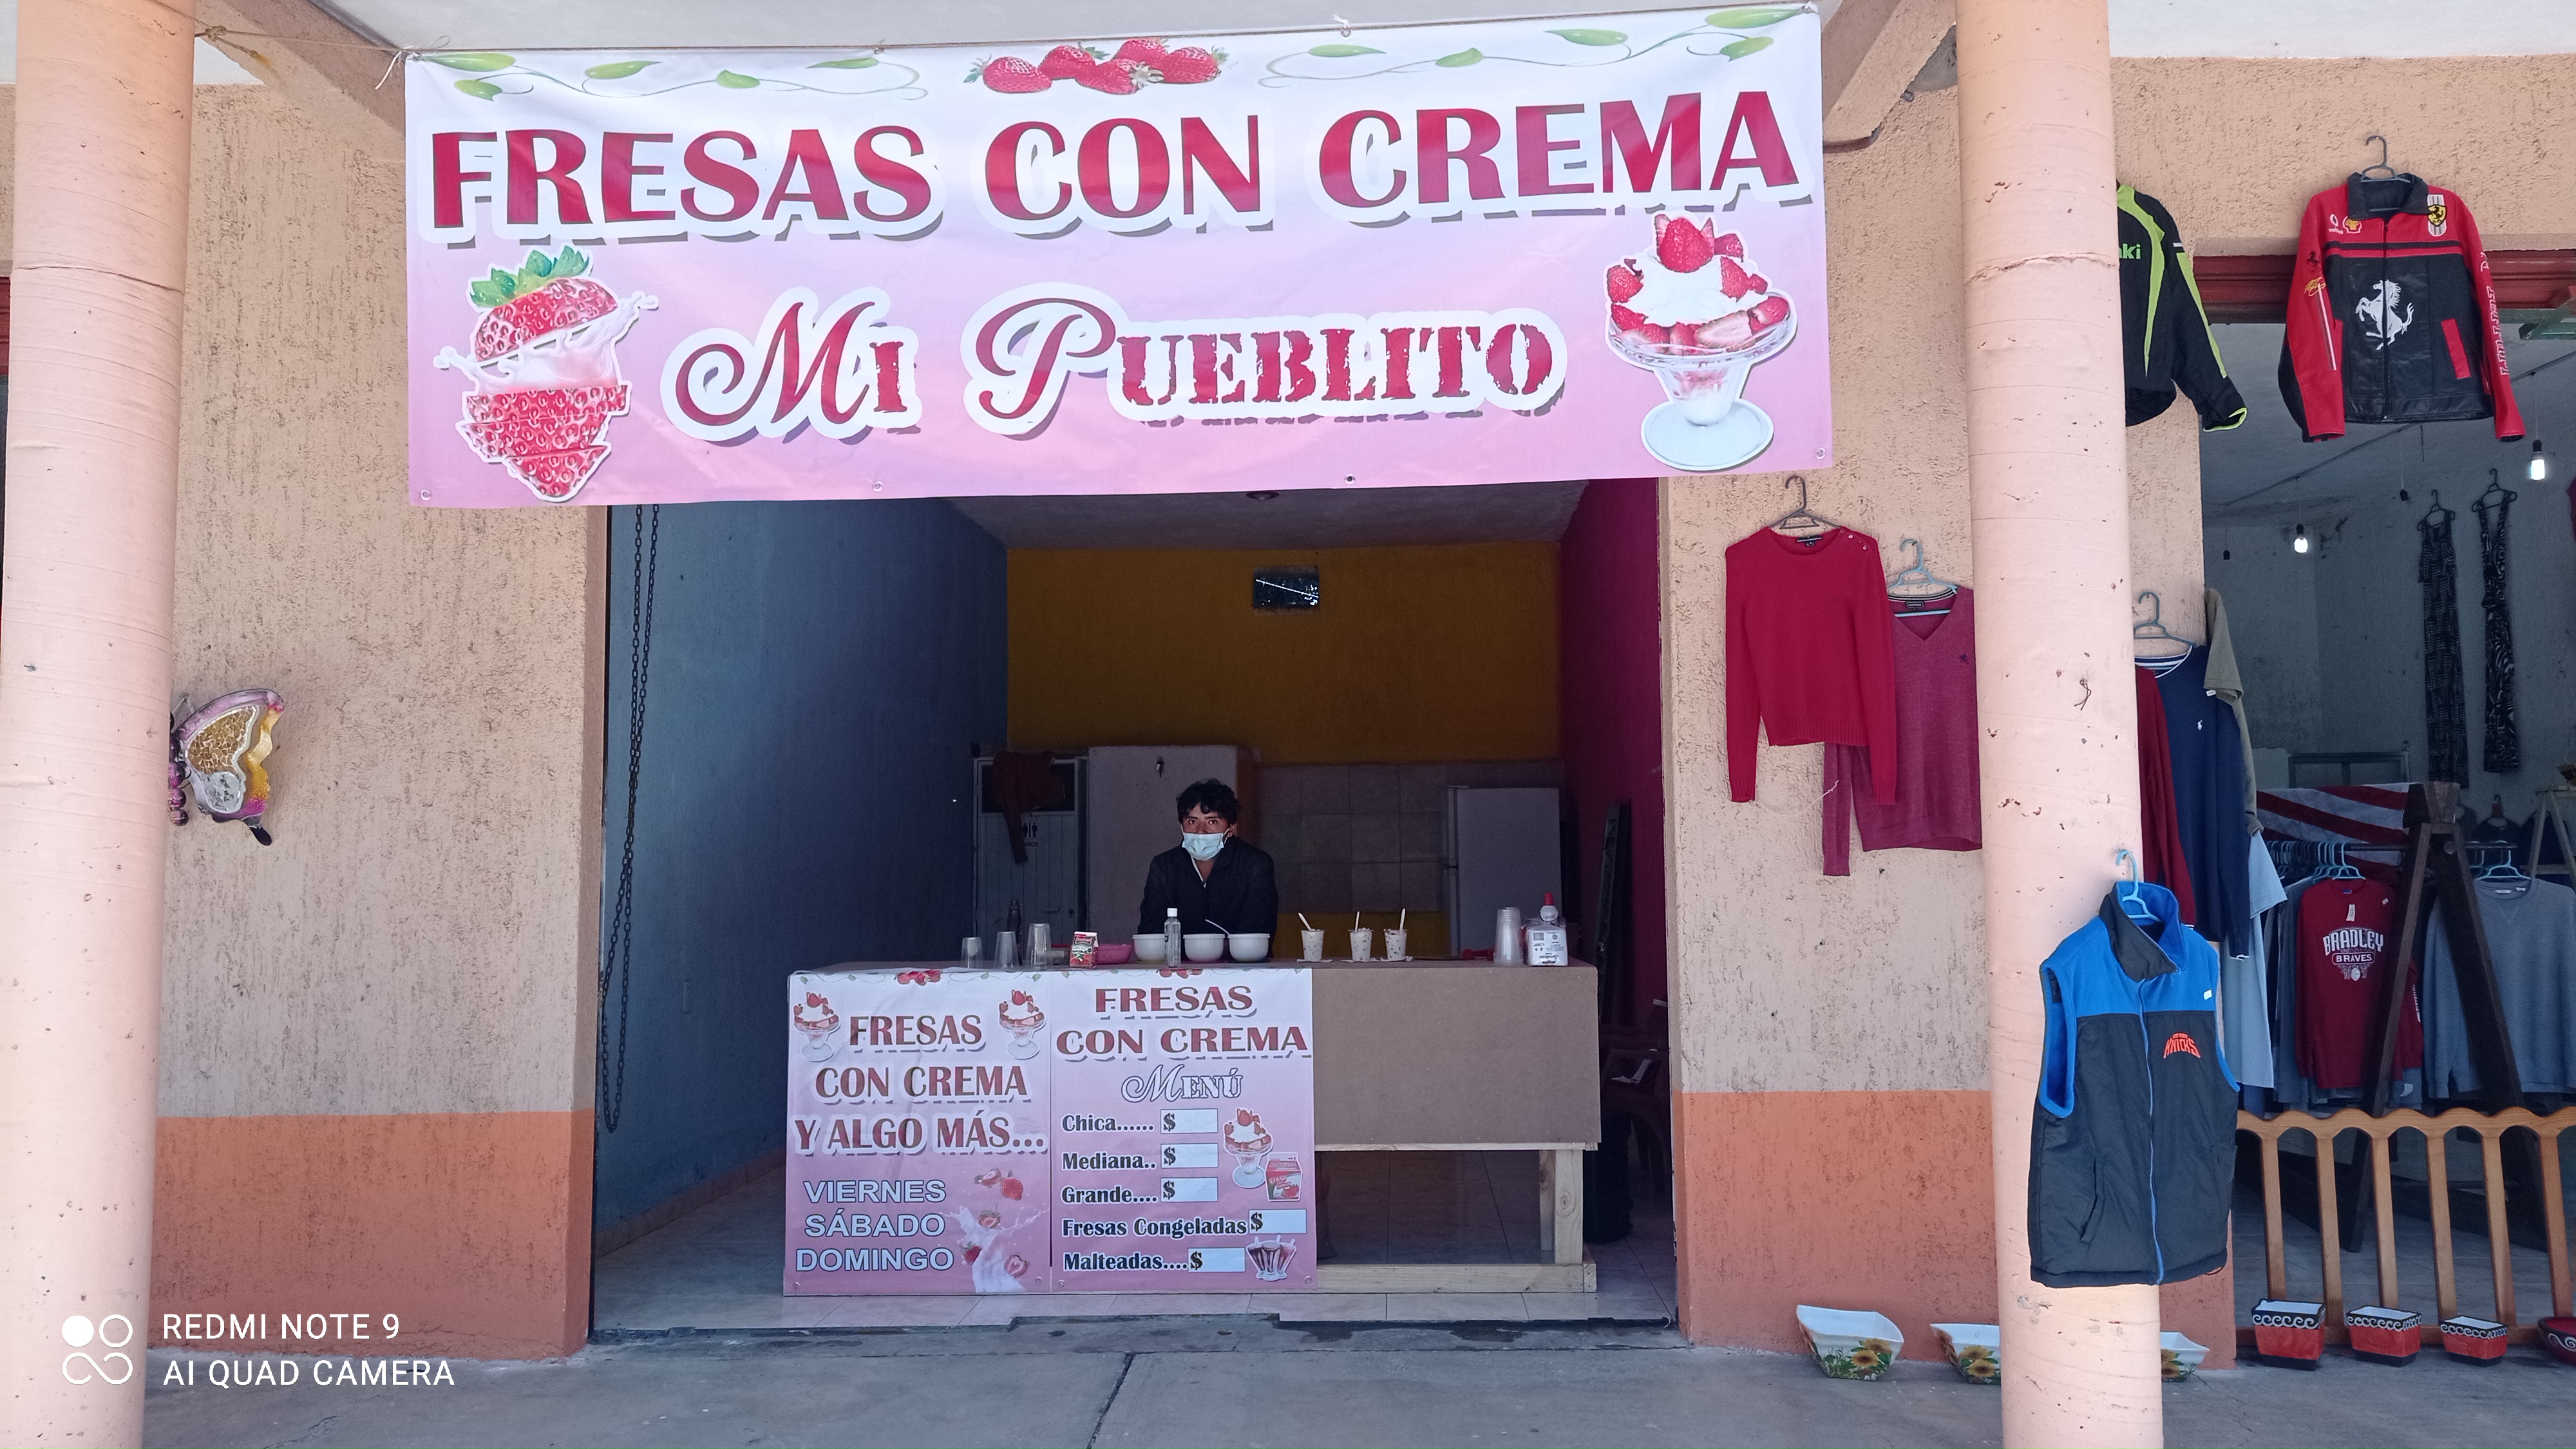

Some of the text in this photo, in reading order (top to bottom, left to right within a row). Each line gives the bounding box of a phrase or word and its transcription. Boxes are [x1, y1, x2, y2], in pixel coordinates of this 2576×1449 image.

[433, 91, 1799, 229] FRESAS CON CREMA
[2322, 929, 2384, 956] BRADLEY
[2336, 954, 2372, 963] BRAVES
[1095, 986, 1253, 1013] FRESAS
[849, 1014, 982, 1046] FRESAS
[1056, 1026, 1308, 1055] CON CREMA
[2163, 1037, 2201, 1059] KNICKS
[815, 1066, 1027, 1098] CON CREMA
[794, 1110, 1045, 1150] Y ALGO MÁS...
[1163, 1113, 1176, 1132] $
[1164, 1147, 1176, 1166] $
[803, 1180, 946, 1203] VIERNES
[1163, 1180, 1176, 1200] $
[804, 1208, 945, 1237] SÁBADO
[1063, 1213, 1263, 1238] Fresas Congeladas $
[796, 1247, 954, 1271] DOMINGO
[1190, 1251, 1203, 1270] $
